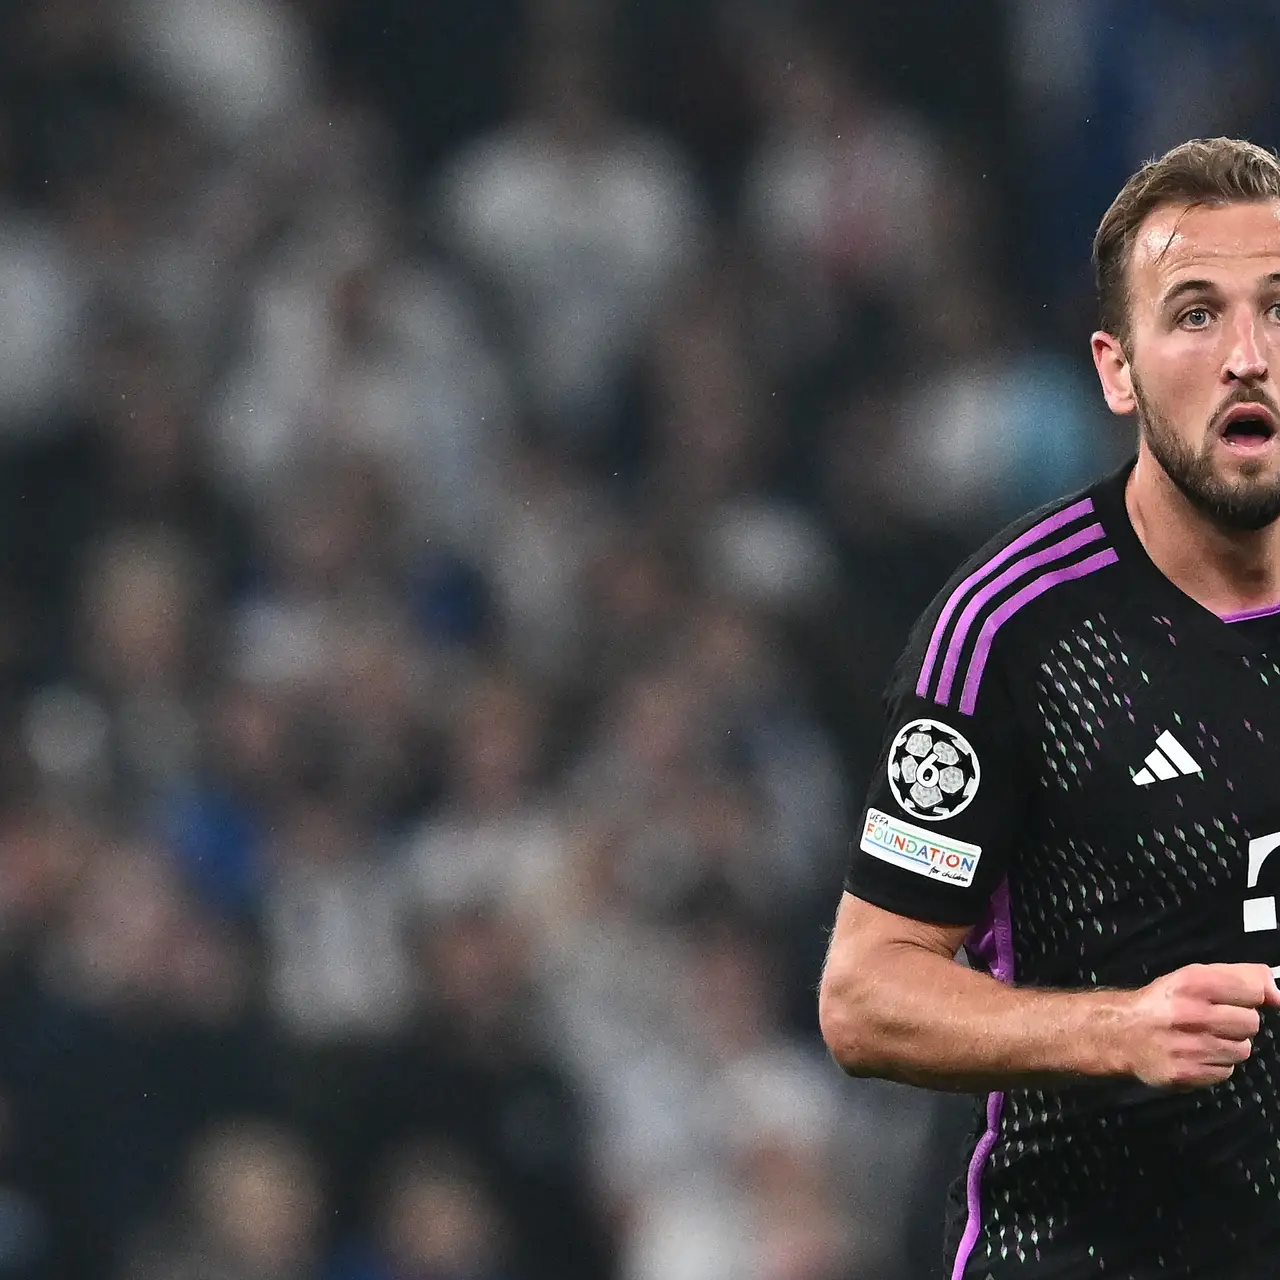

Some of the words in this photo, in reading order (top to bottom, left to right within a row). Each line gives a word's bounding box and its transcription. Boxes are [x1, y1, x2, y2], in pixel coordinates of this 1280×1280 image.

[915, 753, 940, 788] 6
[869, 812, 889, 826] UEFA
[865, 823, 975, 872] FOUNDATION
